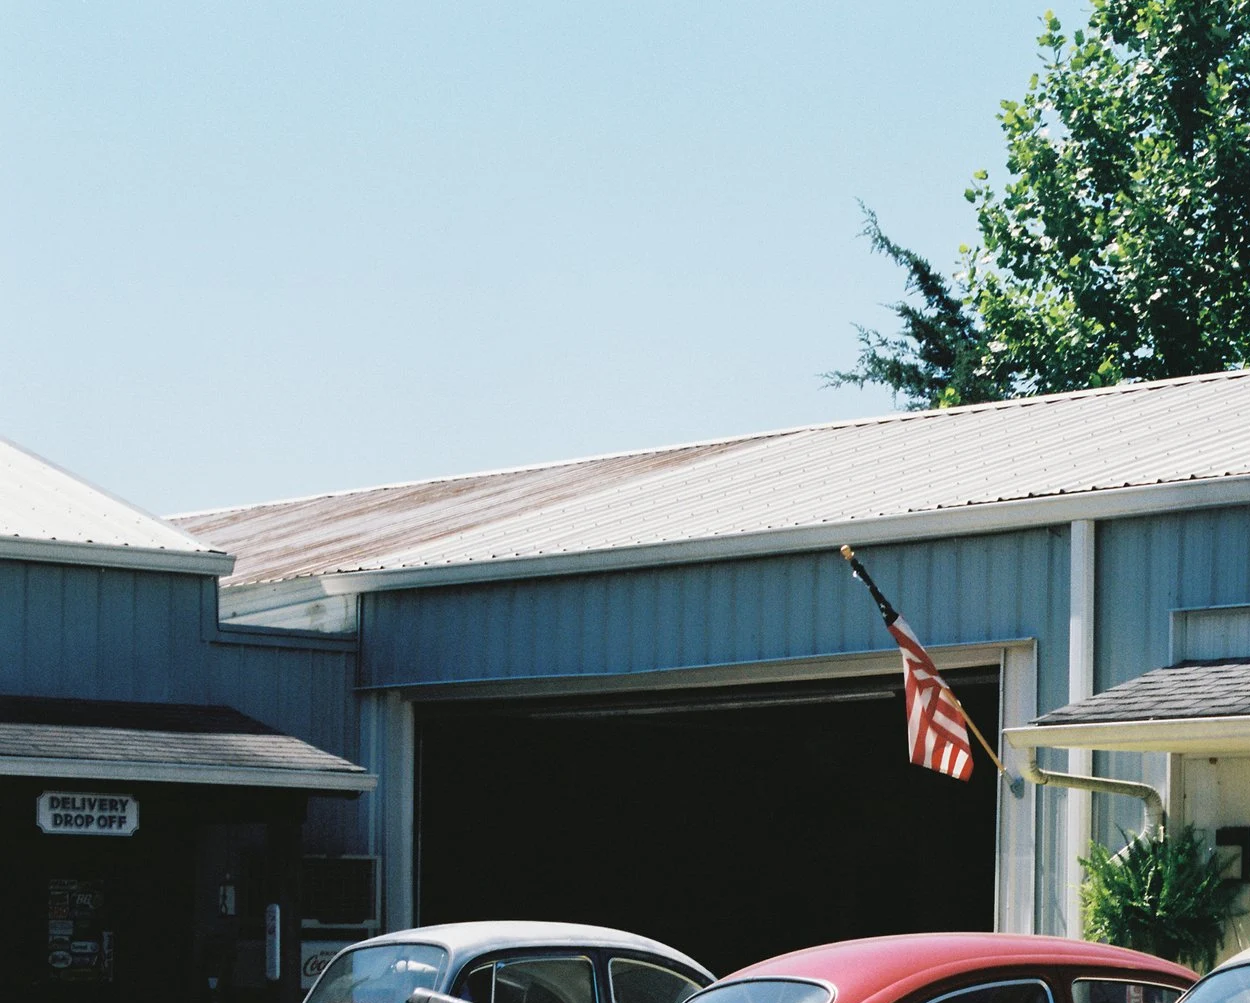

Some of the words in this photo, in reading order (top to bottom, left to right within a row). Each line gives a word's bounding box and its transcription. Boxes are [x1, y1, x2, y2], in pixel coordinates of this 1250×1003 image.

[49, 796, 129, 813] DELIVERY
[52, 813, 95, 829] DROP
[96, 814, 127, 830] OFF
